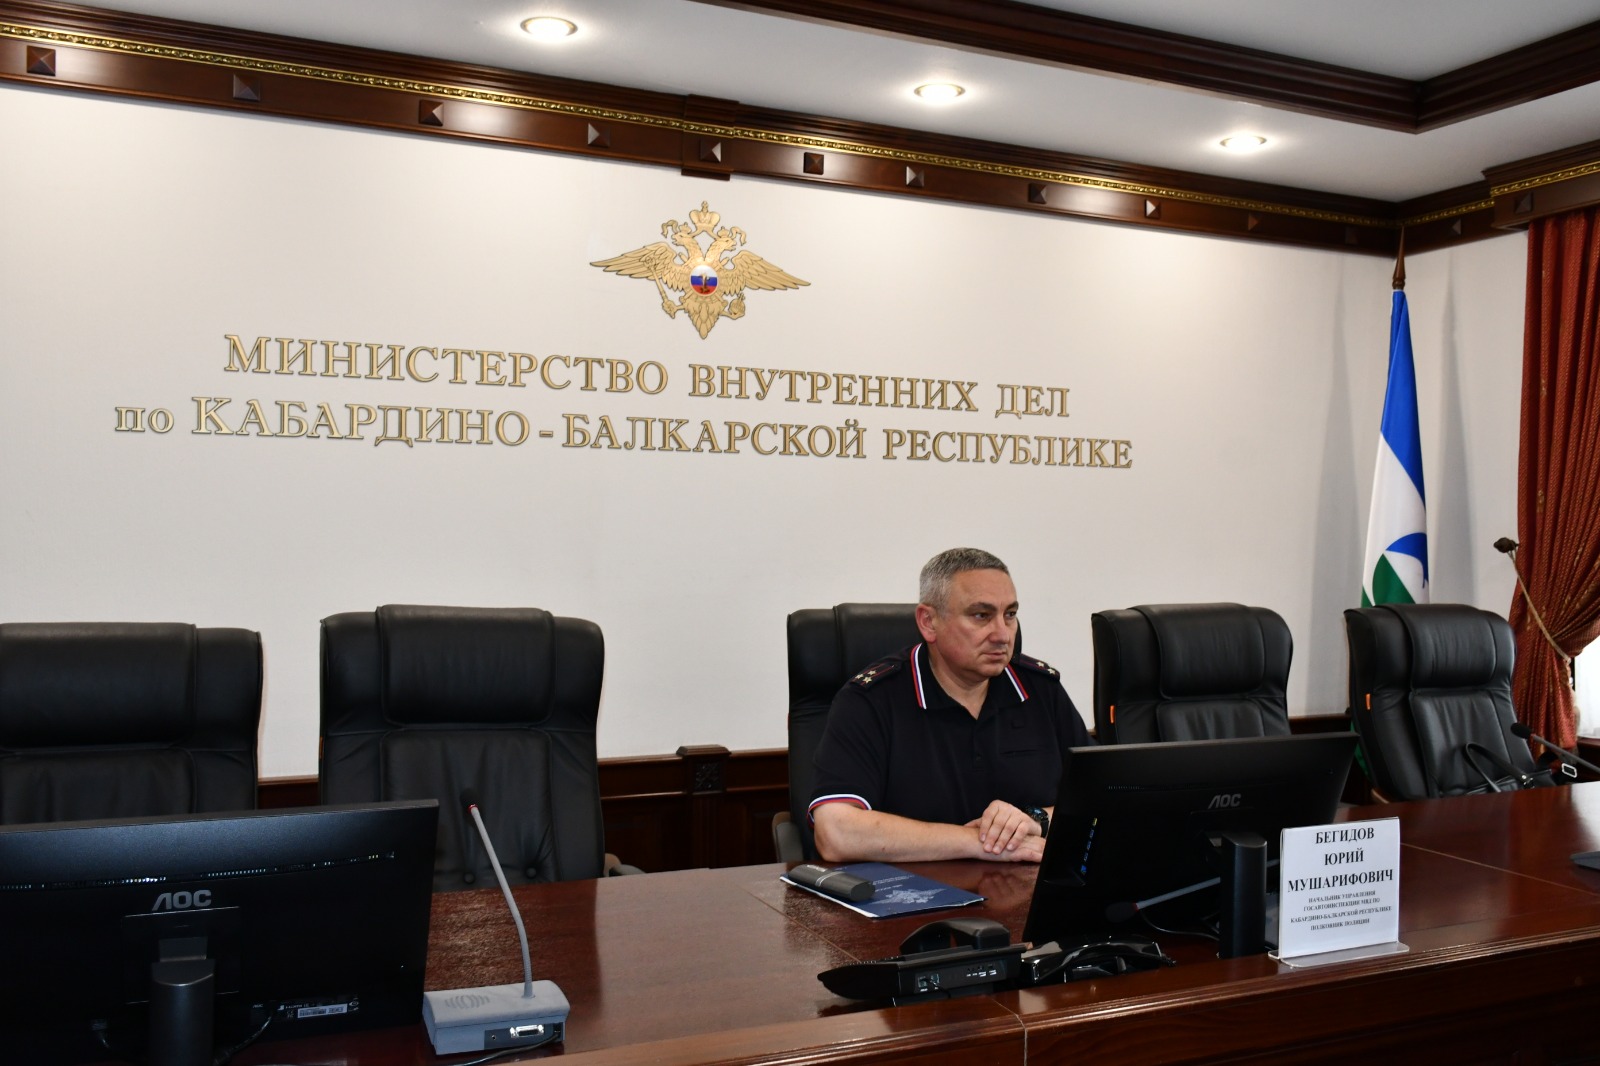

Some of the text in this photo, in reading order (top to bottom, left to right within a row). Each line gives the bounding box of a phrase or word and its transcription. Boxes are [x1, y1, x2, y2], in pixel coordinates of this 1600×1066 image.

[224, 334, 1070, 419] МИНИСТЕРСТВО ВНУТРЕННИХ ДЕЛ
[115, 406, 175, 434] по
[882, 428, 1133, 469] РЕСПУБЛИКЕ
[1208, 793, 1241, 809] AOC
[1315, 827, 1375, 845] БЕГИДОВ
[1324, 848, 1364, 866] ЮРИЙ
[1287, 869, 1394, 893] МУШАРИФОВИЧ
[151, 889, 212, 911] AOC
